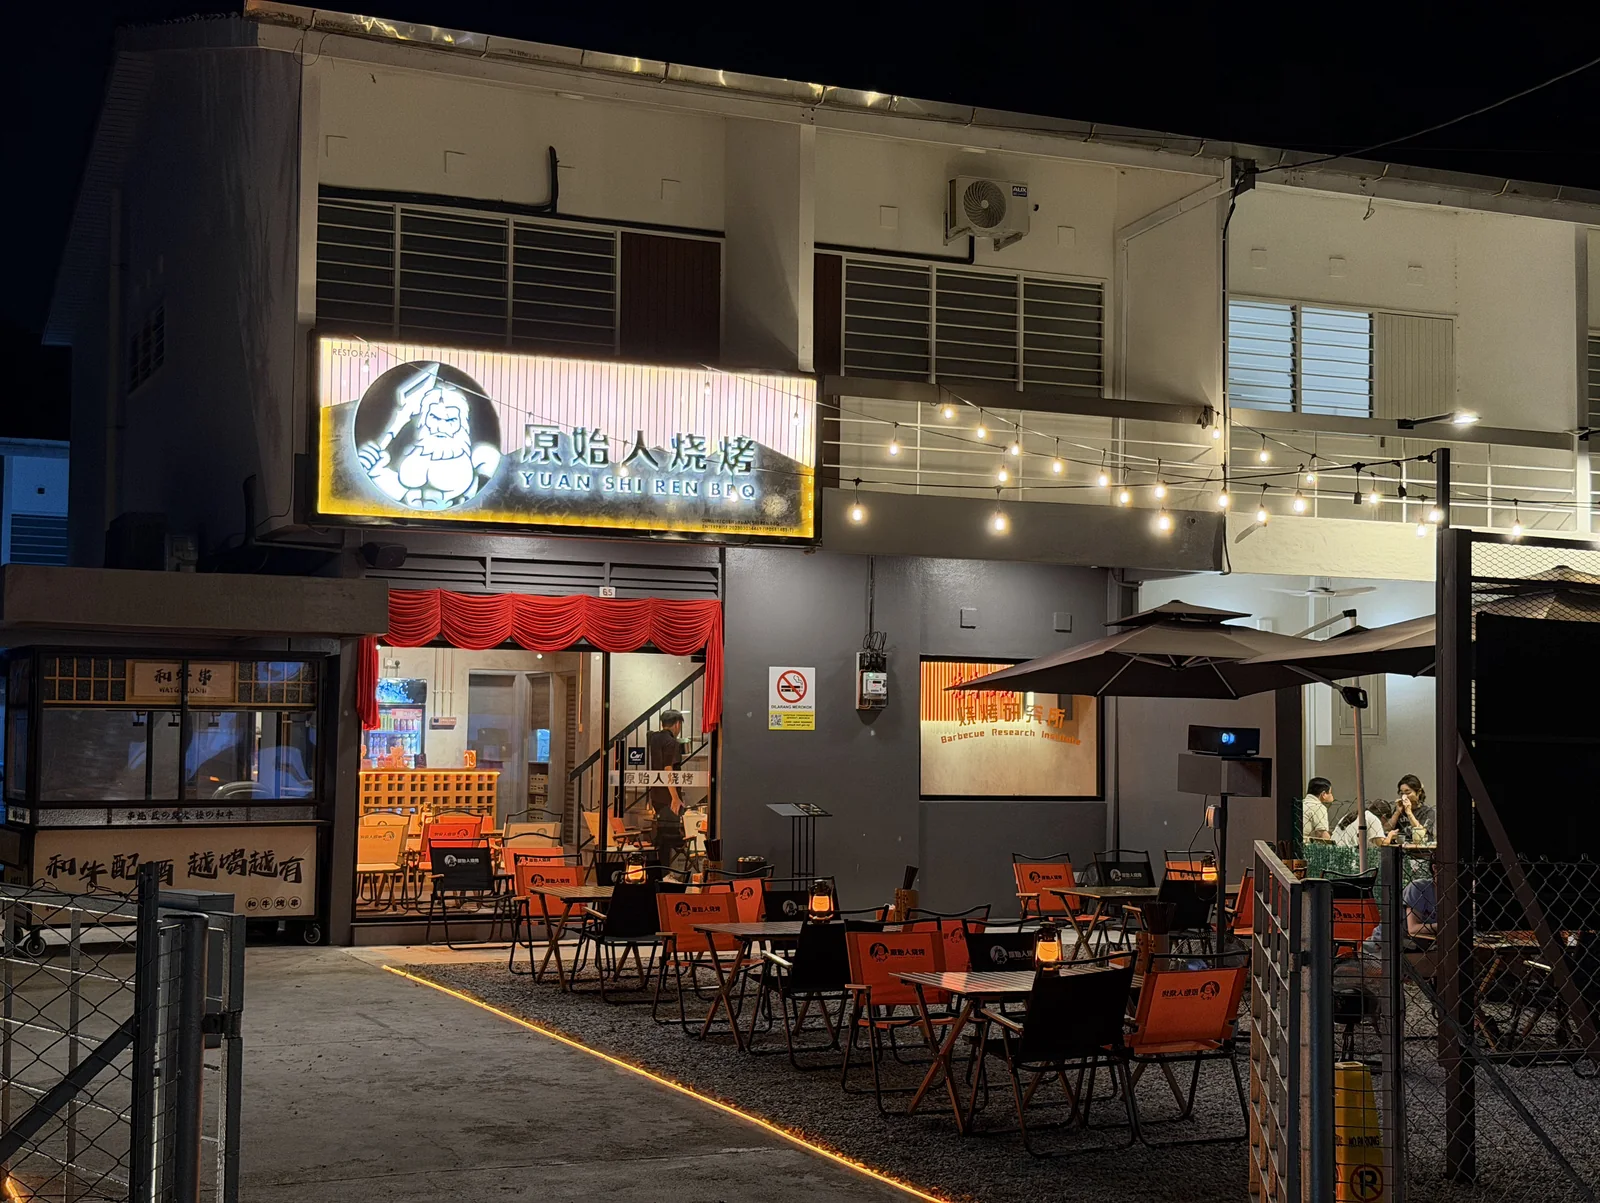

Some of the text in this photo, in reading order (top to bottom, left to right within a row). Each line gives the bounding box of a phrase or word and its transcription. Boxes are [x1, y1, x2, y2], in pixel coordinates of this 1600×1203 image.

[332, 349, 377, 358] RESTORAN
[520, 424, 755, 475] 原始人烧烤
[521, 471, 591, 491] YUAN
[602, 476, 643, 495] SHI
[654, 479, 699, 497] REN
[602, 588, 613, 597] 65
[957, 703, 1066, 728] 烧烤研究所
[941, 730, 985, 744] Barbecue
[992, 728, 1035, 737] Research
[625, 772, 694, 785] 原始人烧烤
